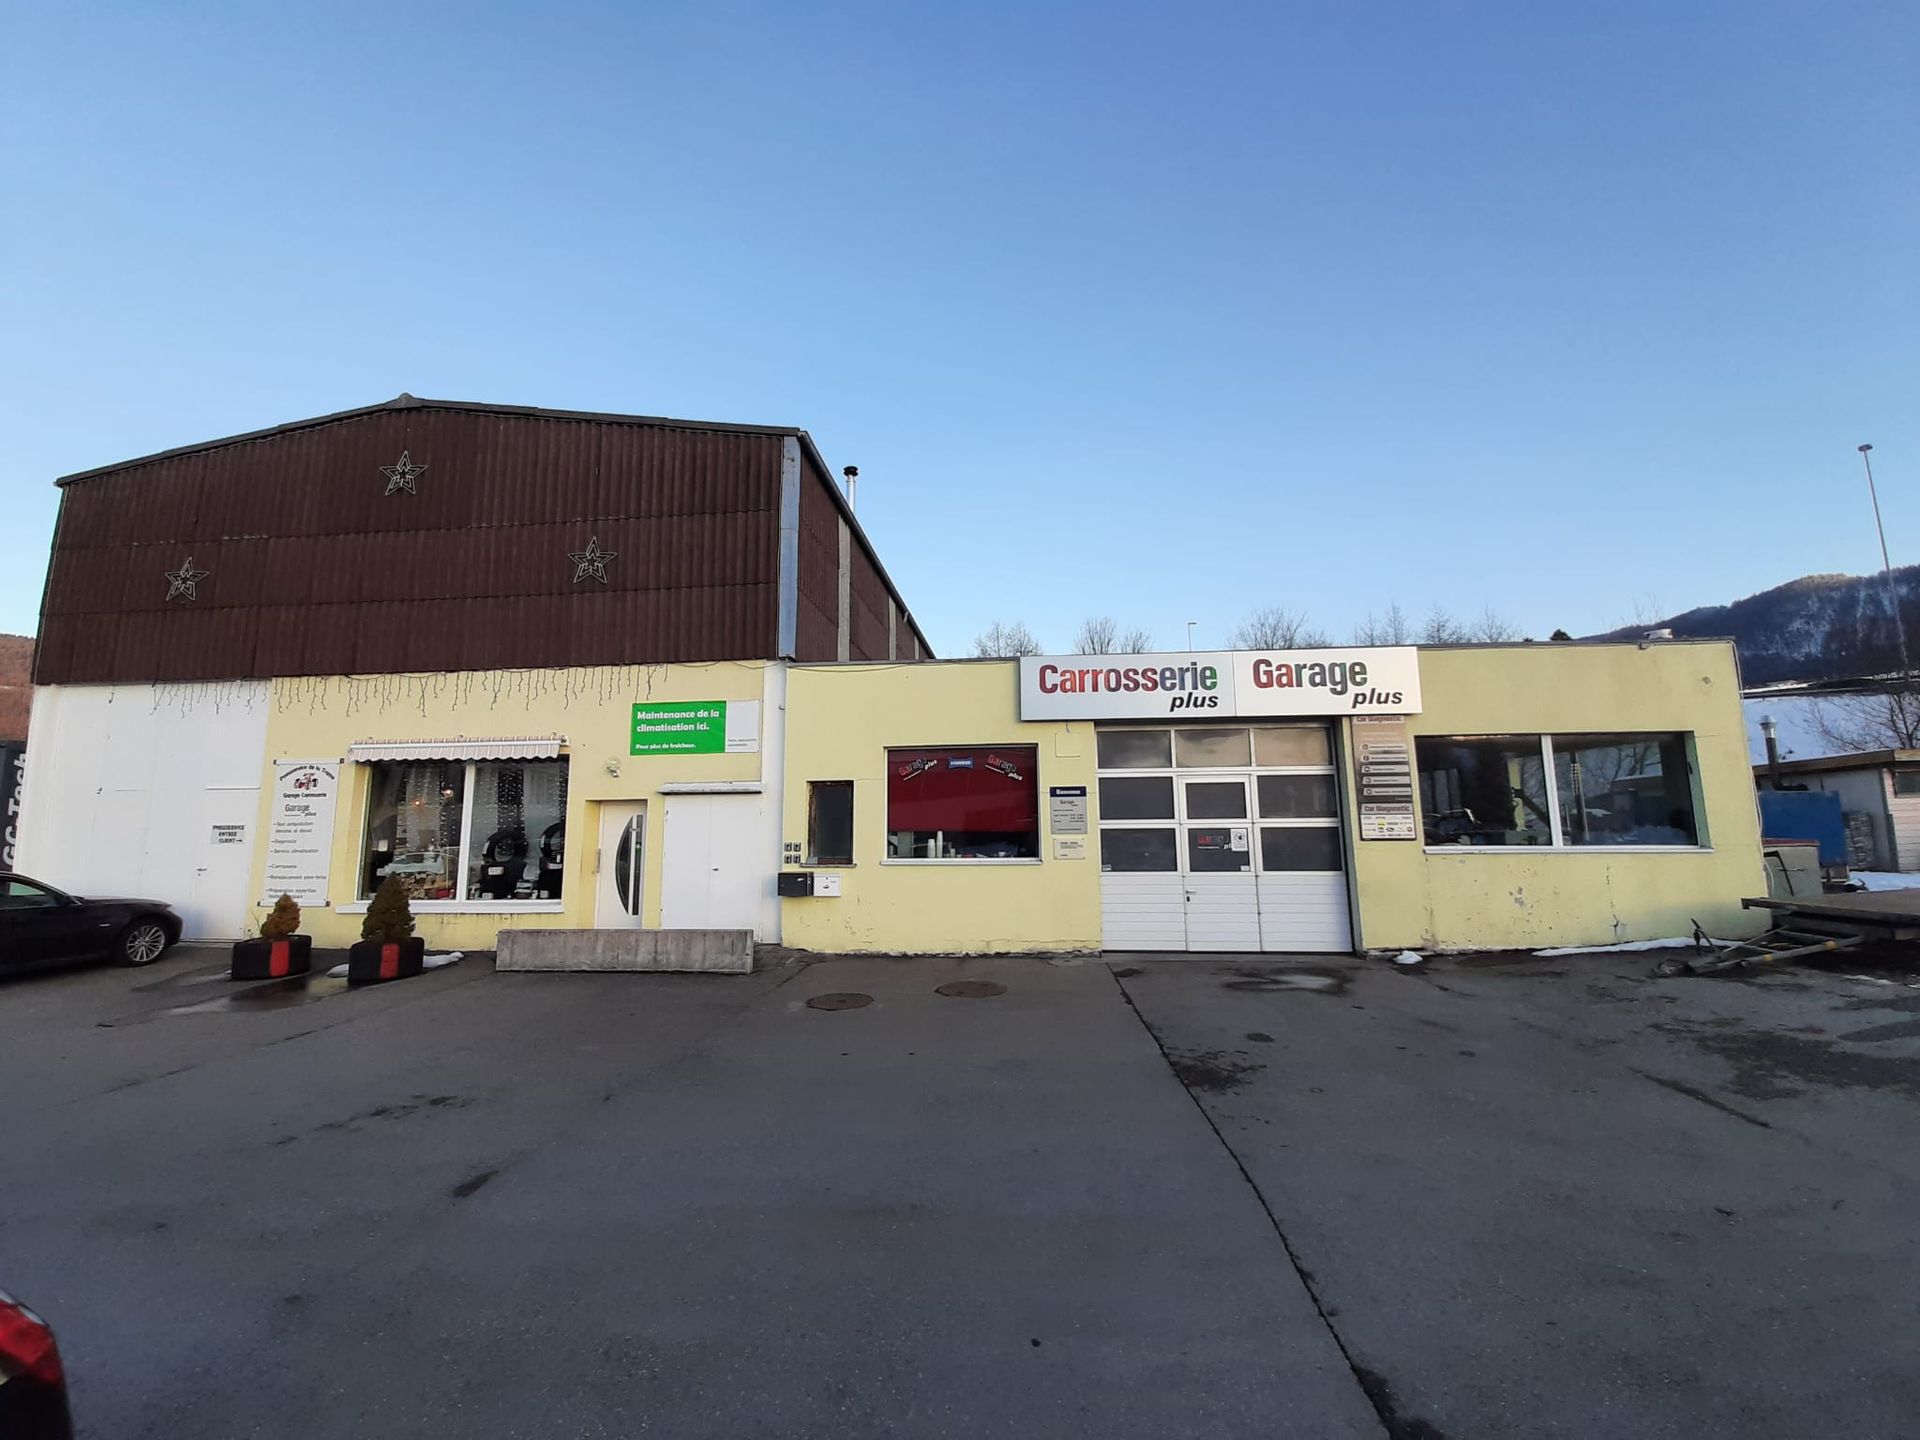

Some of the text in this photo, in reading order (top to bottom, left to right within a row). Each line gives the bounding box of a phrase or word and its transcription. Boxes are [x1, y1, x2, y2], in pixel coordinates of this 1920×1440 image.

[1039, 661, 1218, 694] Carrosserie
[1252, 658, 1368, 696] Garage
[1169, 692, 1219, 713] plus
[1351, 687, 1404, 709] plus
[637, 709, 720, 720] Maintenance de la
[636, 721, 710, 733] climatisation ici.
[285, 804, 310, 814] Garage
